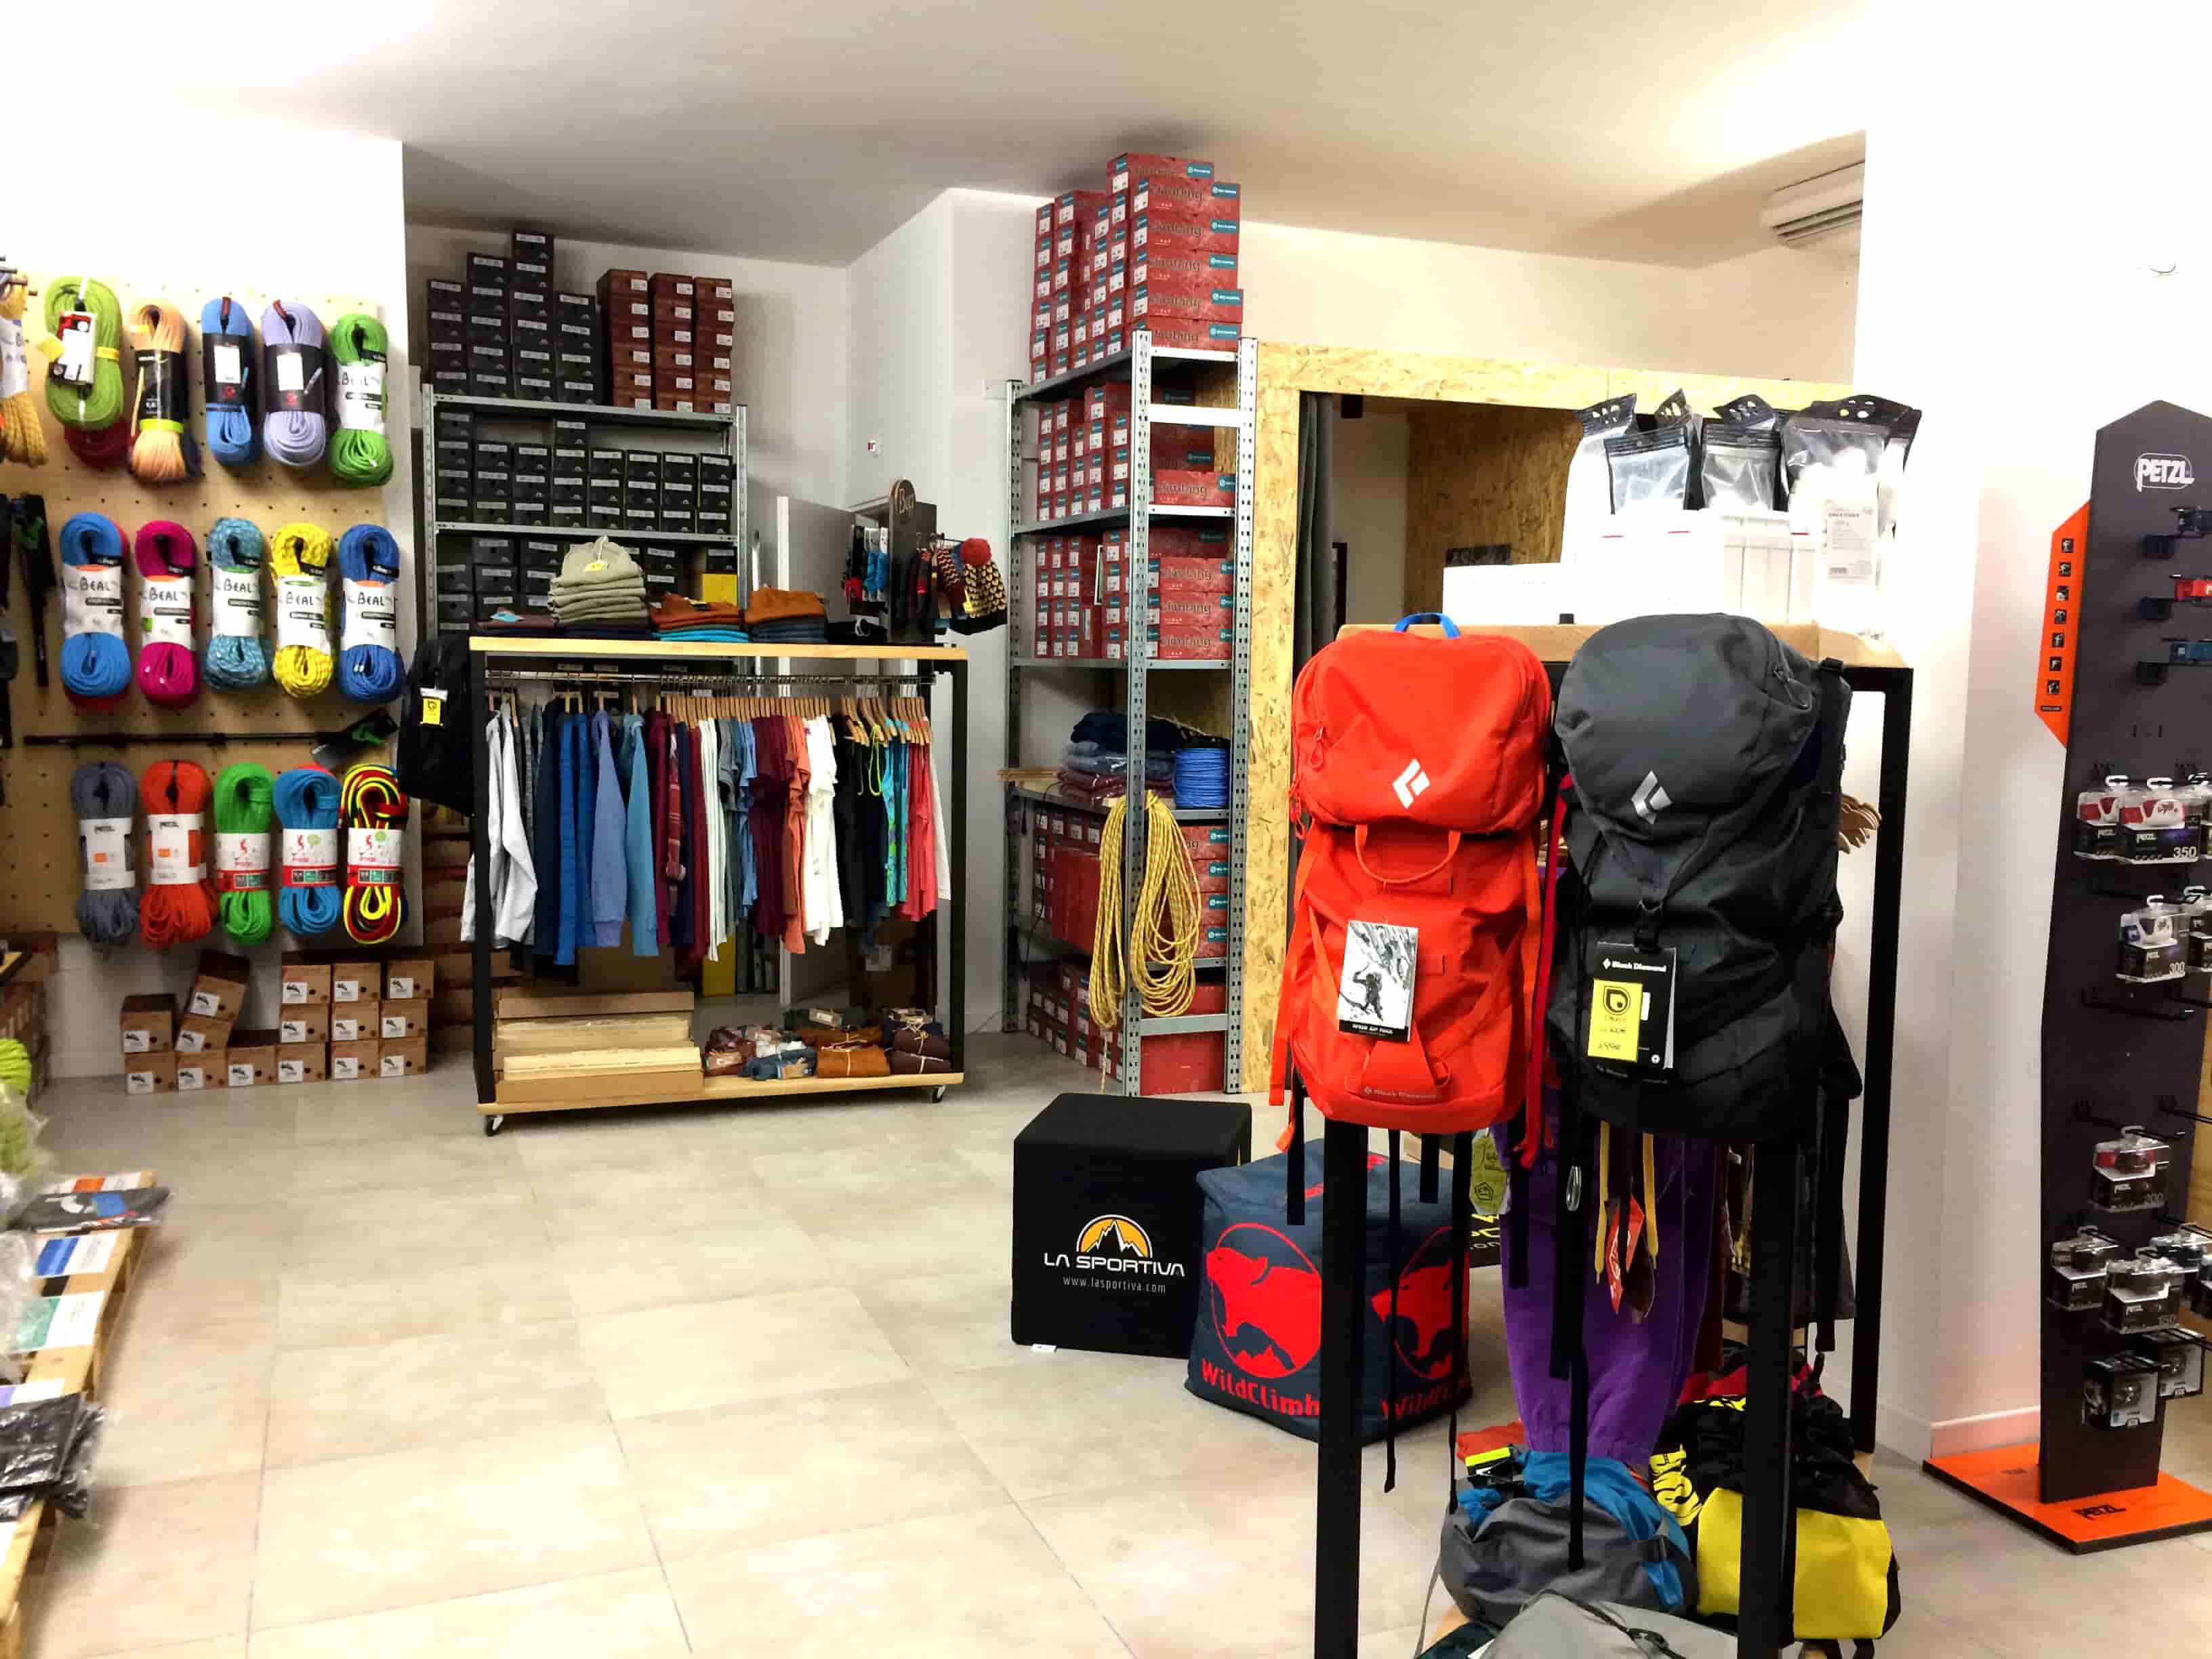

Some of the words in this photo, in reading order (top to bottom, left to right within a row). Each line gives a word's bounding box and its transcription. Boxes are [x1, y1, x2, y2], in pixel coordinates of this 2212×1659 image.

[2137, 459, 2194, 492] PETZL
[79, 577, 110, 591] BEAL
[224, 578, 252, 592] BEAL
[149, 587, 178, 601] BEAL
[286, 592, 314, 606] BEAL
[358, 592, 385, 606] BEAL
[2173, 846, 2196, 858] 350
[1044, 1252, 1070, 1268] LA
[1076, 1255, 1185, 1277] SPORTIVA
[1063, 1275, 1166, 1294] www.lasportiva.com
